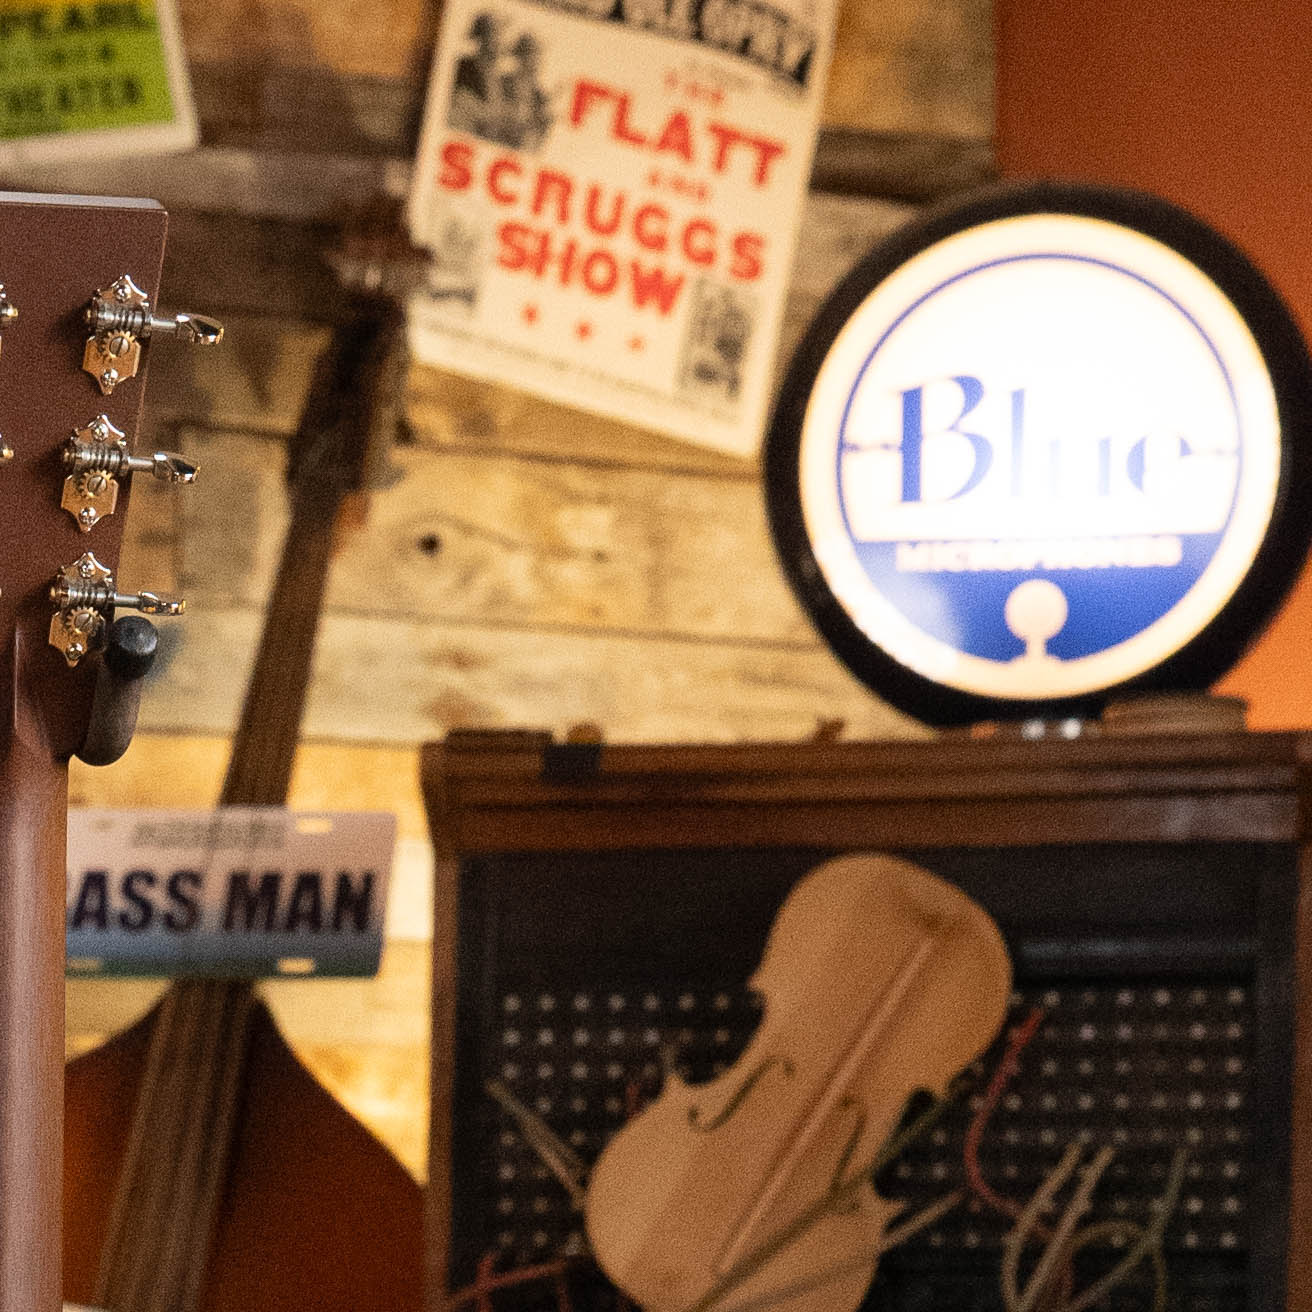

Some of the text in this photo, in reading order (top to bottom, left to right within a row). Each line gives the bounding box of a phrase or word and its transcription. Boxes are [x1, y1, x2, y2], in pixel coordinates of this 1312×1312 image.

[569, 77, 786, 188] FLATT
[438, 140, 765, 283] SCRUGGS
[496, 220, 685, 317] SHOW
[222, 869, 377, 934] MAN
